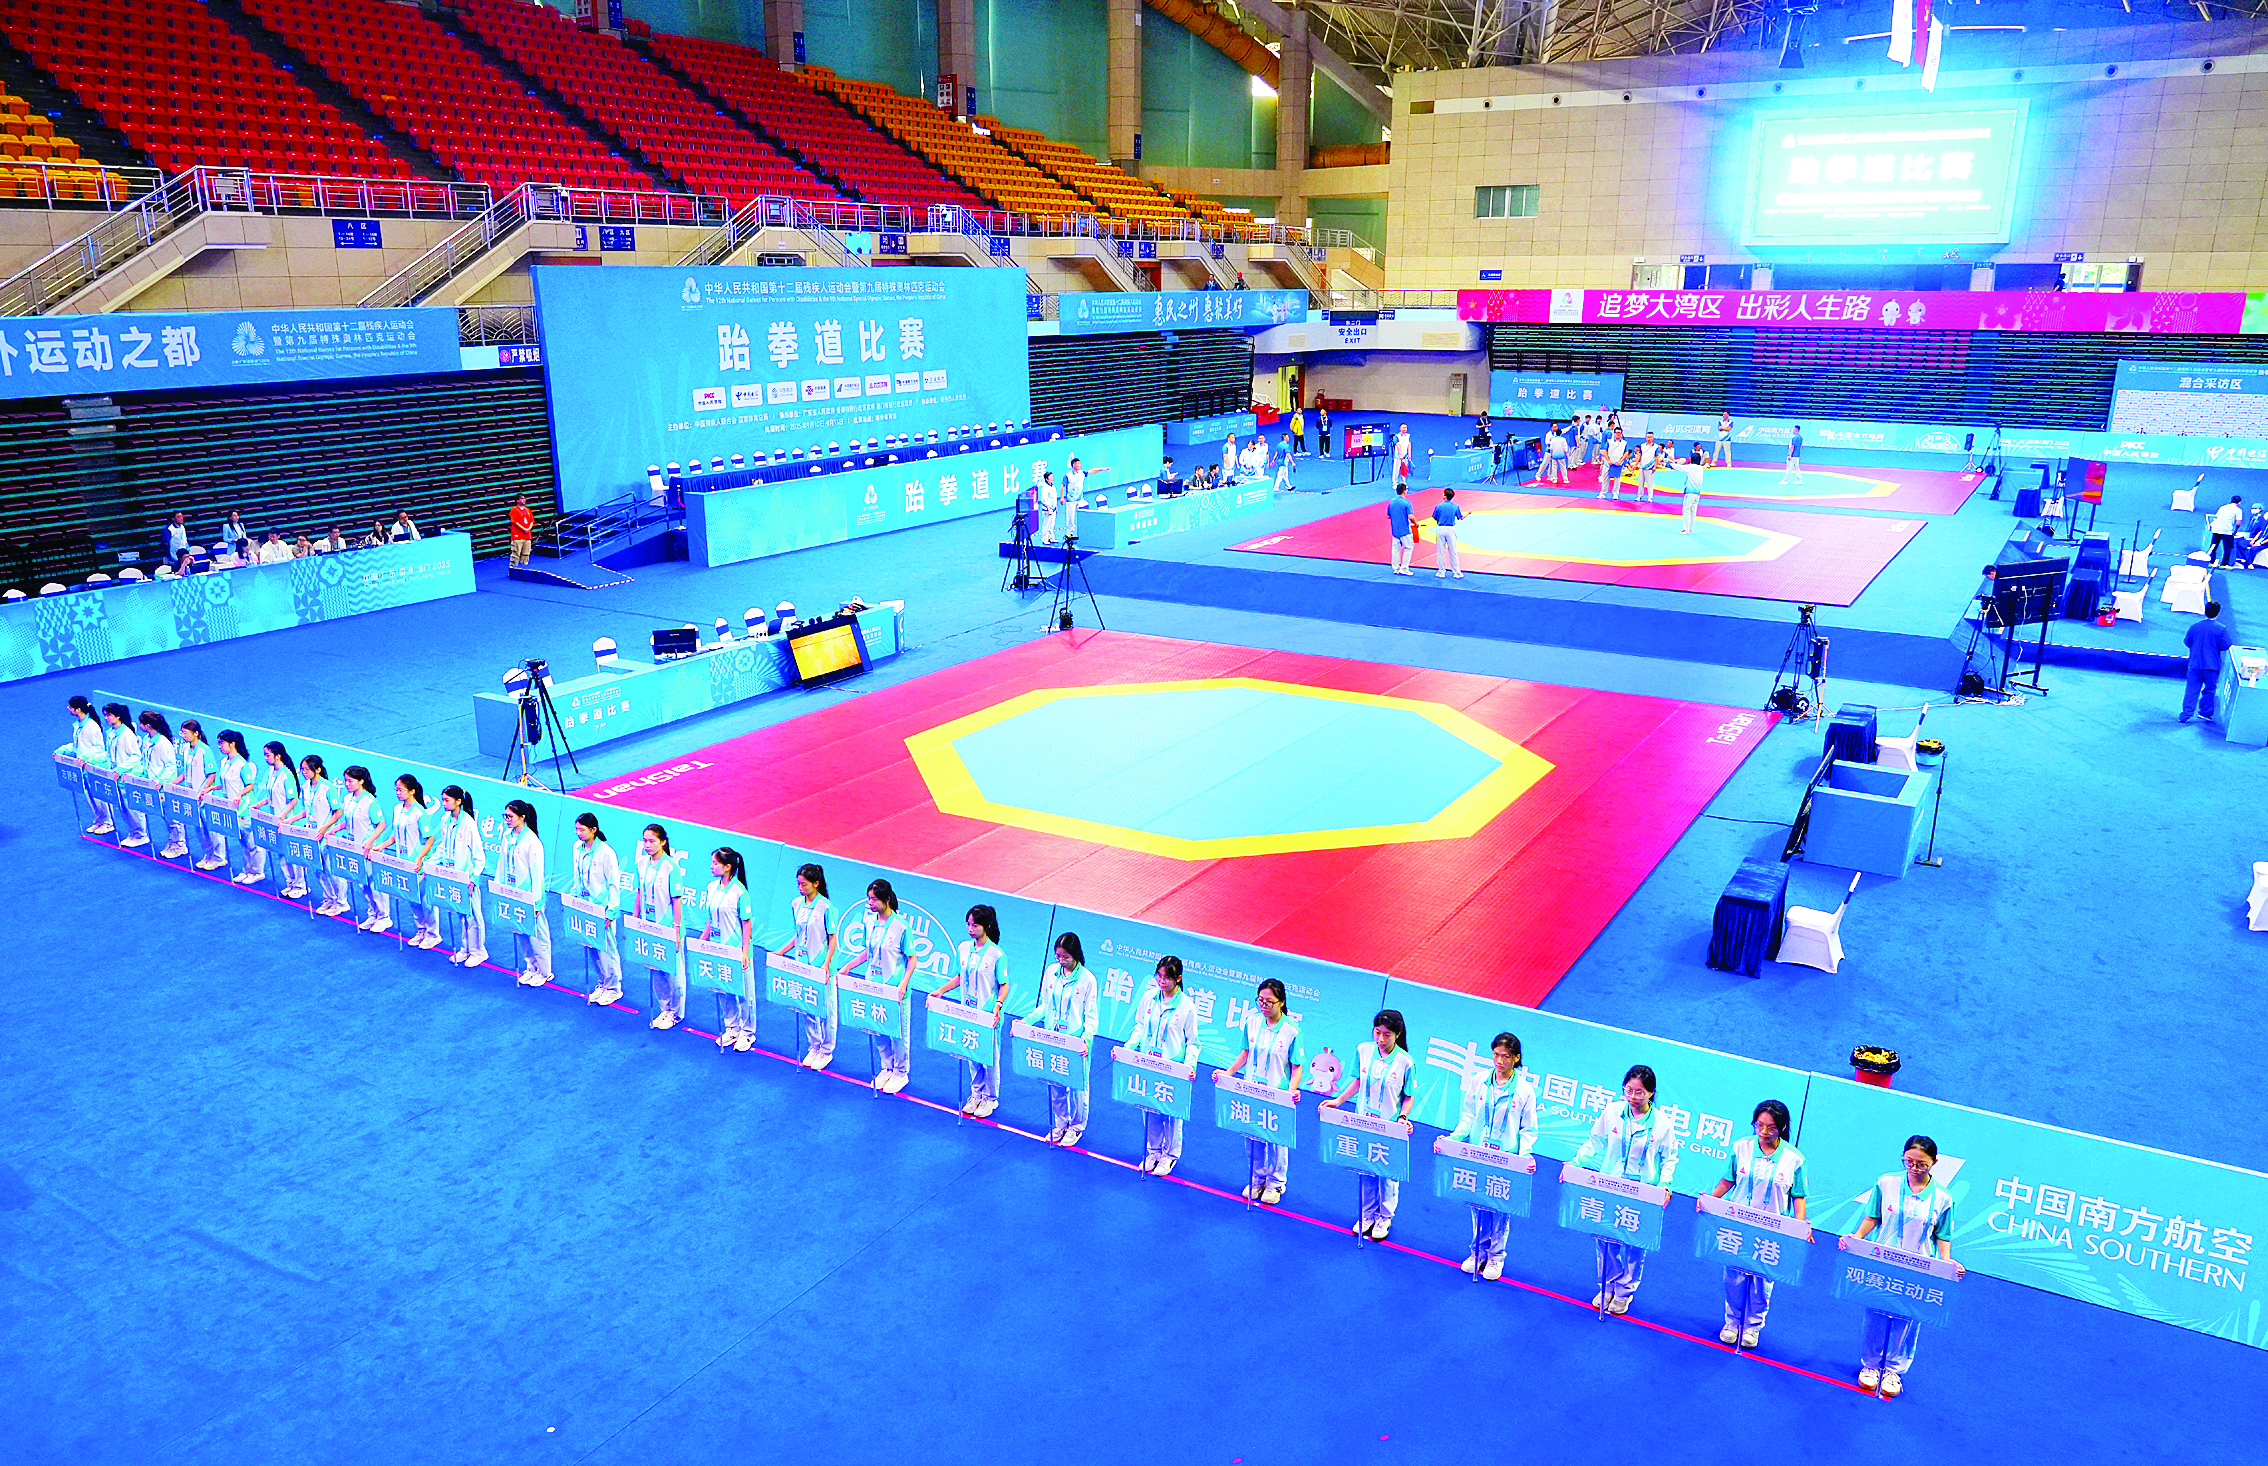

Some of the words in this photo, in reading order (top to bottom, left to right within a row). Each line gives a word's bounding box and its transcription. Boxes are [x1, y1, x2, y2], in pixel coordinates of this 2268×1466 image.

[704, 281, 946, 295] 中华人民共和国第十二届残疾人运动会暨第九届特殊奥林匹克运动会
[1597, 293, 1724, 319] 追梦大湾区
[1736, 294, 1872, 321] 出彩人生路
[272, 320, 414, 334] 中华人民共和国第十二届残疾人运动会
[273, 332, 416, 346] 暨第九届特殊奥林匹克运动会
[1338, 328, 1367, 336] 安全出口
[717, 317, 925, 371] 跆拳道比赛
[1517, 387, 1593, 400] 跆拳道比赛
[2179, 377, 2243, 390] 混合采访区
[1758, 426, 1793, 434] 中国南方航
[2103, 450, 2159, 458] 中国人民保险
[2120, 441, 2145, 450] PICC
[2226, 448, 2267, 458] 中国电信
[905, 460, 1047, 512] 跆拳道比赛
[432, 560, 450, 570] 2025
[565, 700, 630, 729] 跆拳道比赛
[1705, 713, 1757, 745] TaiShan
[95, 780, 112, 796] 广东
[593, 760, 714, 799] TaiShan
[133, 790, 154, 808] 宁夏
[172, 799, 193, 818] 甘肃
[211, 810, 233, 830] 四川
[257, 825, 277, 845] 湖南
[290, 841, 314, 860] 河南
[335, 854, 360, 875] 江西
[380, 869, 410, 892] 浙江
[434, 883, 462, 904] 上海
[498, 901, 527, 924] 辽宁
[570, 915, 598, 939] 山西
[634, 938, 667, 962] 北京
[698, 960, 733, 984] 天津
[772, 976, 819, 1006] 内蒙古
[1103, 968, 1302, 1031] 跆道比
[850, 998, 888, 1023] 吉林
[939, 1021, 980, 1050] 江苏
[1025, 1046, 1070, 1076] 福建
[1128, 1073, 1175, 1104] 山东
[1230, 1100, 1279, 1132] 湖北
[1517, 1065, 1734, 1147] 中国南电网
[1336, 1134, 1390, 1166] 重庆
[1690, 1143, 1728, 1160] GRID
[1452, 1166, 1512, 1202] 西藏
[1580, 1196, 1641, 1232] 青海
[1994, 1175, 2254, 1267] 中国南方航空
[1716, 1226, 1780, 1266] 香港
[1987, 1210, 2073, 1250] CHINA
[2084, 1234, 2246, 1292] SOUTHERN
[1845, 1264, 1944, 1306] 观赛运动员
